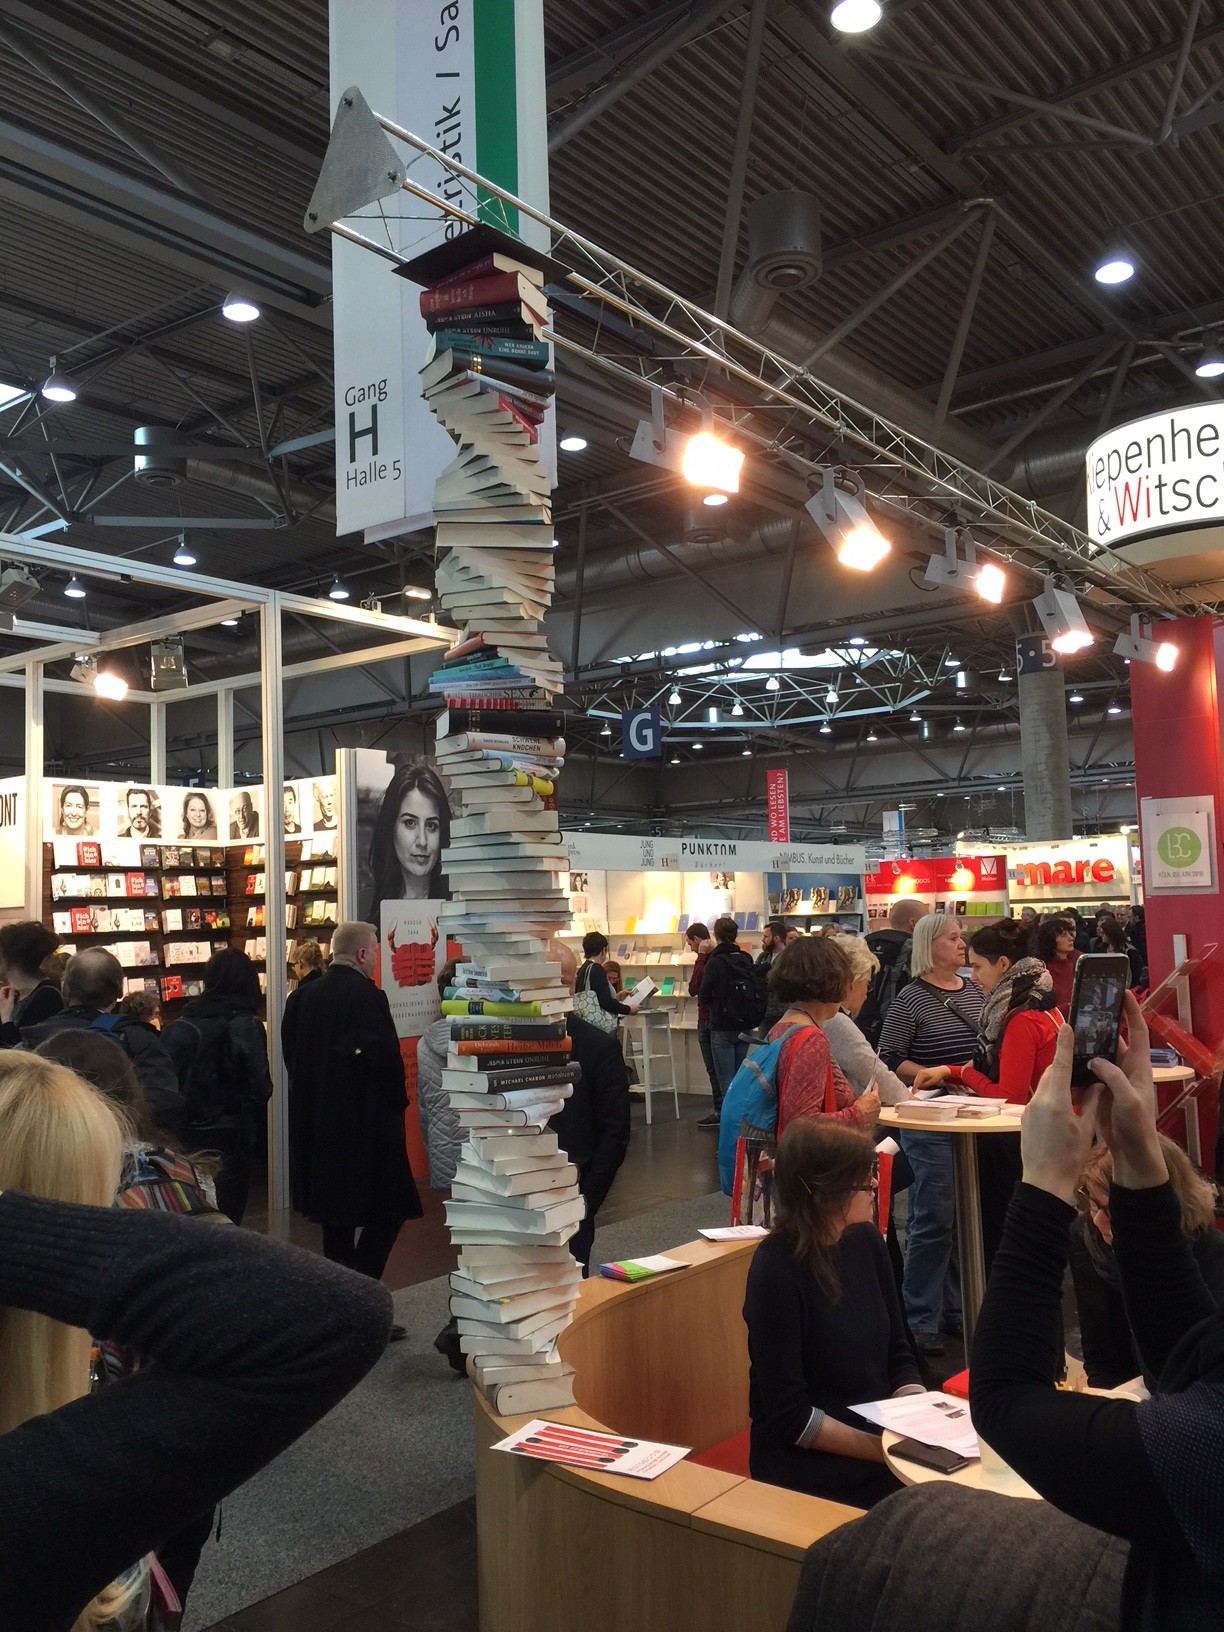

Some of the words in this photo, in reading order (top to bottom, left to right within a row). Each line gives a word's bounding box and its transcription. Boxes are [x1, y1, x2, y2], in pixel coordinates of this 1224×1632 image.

[473, 310, 497, 319] AISHA
[344, 378, 388, 407] Gang
[349, 403, 378, 464] H
[346, 460, 387, 490] Halle
[393, 459, 401, 481] 5
[1097, 499, 1111, 536] &
[1042, 640, 1056, 667] 5
[504, 689, 526, 698] SEX
[629, 712, 653, 752] G
[512, 743, 541, 752] KNOCHEN
[769, 783, 777, 810] LESEN
[777, 772, 786, 817] LIEBSTEN?
[770, 811, 777, 828] WO
[778, 818, 786, 834] AM
[640, 840, 654, 849] JUNG
[643, 849, 654, 858] UND
[808, 852, 824, 864] Kunst
[824, 853, 835, 865] und
[836, 853, 855, 865] Bücher
[640, 858, 655, 867] JUNG
[1016, 858, 1115, 886] mare
[505, 1057, 524, 1065] STEIN
[500, 1077, 524, 1085] MICHAEL
